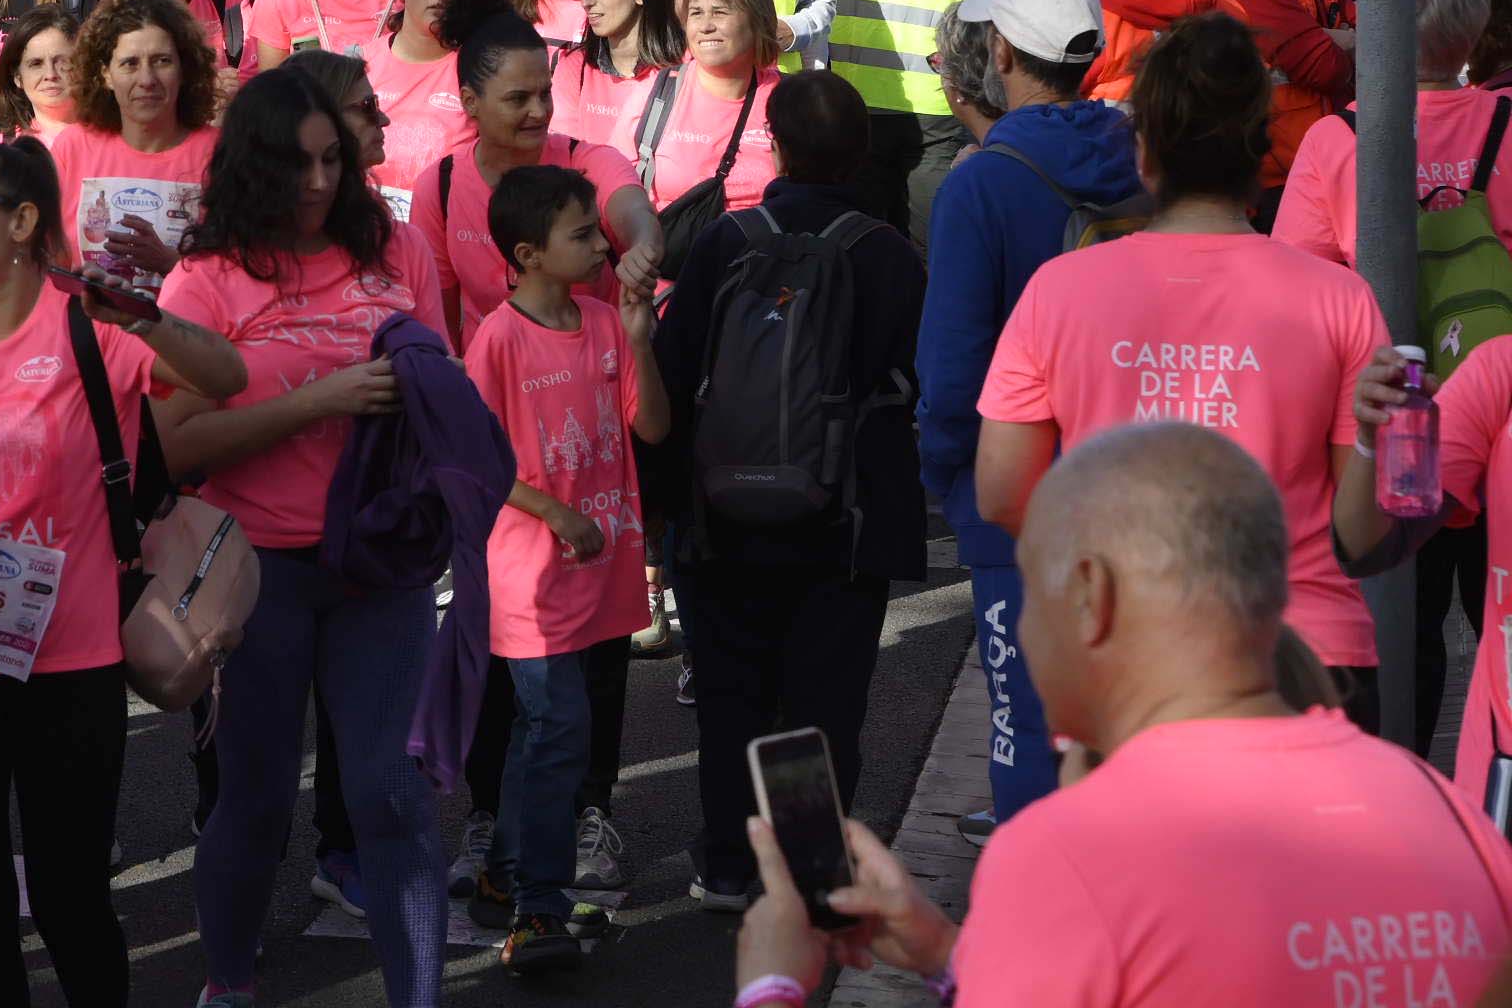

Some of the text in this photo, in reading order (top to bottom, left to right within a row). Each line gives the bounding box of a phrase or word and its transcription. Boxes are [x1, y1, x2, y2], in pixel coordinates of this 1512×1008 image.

[115, 195, 160, 207] ASTURIANA
[1110, 340, 1261, 372] CARRERA
[521, 370, 572, 394] OYSHO
[1140, 372, 1232, 398] DE LA
[983, 598, 1016, 767] BARÇA
[1288, 910, 1485, 970] CARRERA
[1334, 965, 1456, 1008] DE LA
